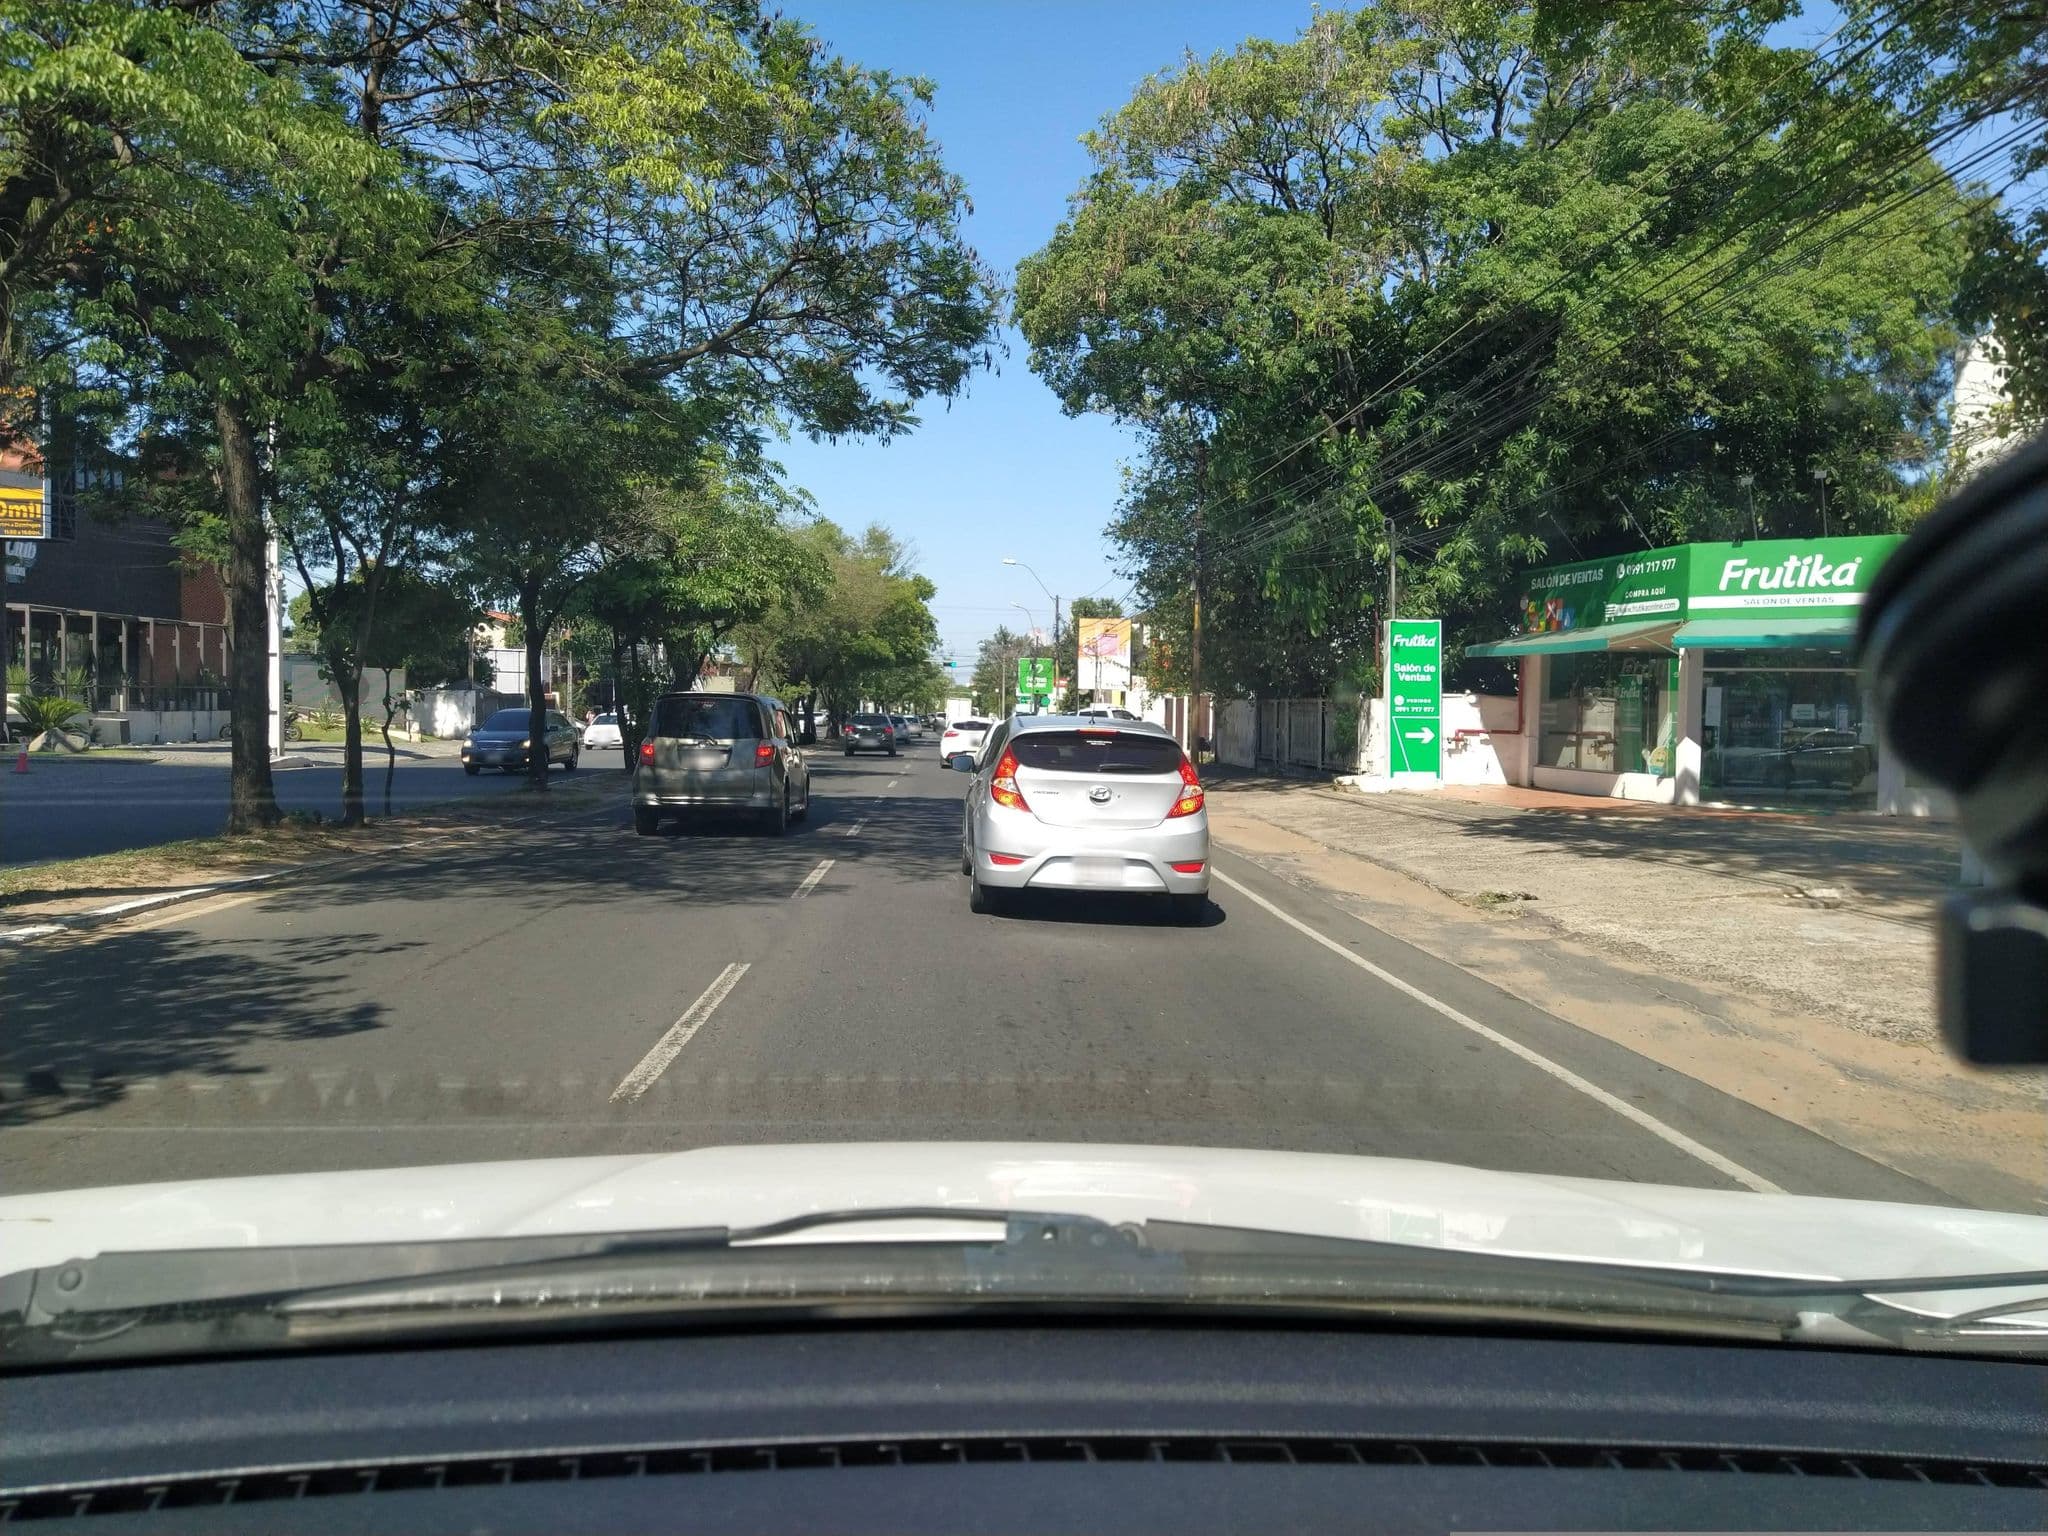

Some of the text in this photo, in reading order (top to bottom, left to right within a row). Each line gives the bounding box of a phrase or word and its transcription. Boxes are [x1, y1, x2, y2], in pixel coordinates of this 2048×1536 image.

[1646, 560, 1661, 574] 717
[1662, 558, 1677, 572] 977
[1718, 553, 1858, 591] Frutika
[1560, 573, 1571, 587] DE
[1572, 568, 1604, 585] VENTAS
[1625, 588, 1649, 599] COMPRA
[1795, 595, 1834, 605] VENTAS
[1393, 634, 1436, 647] Frutika
[1393, 662, 1436, 673] Salón de
[1398, 672, 1432, 682] Ventas
